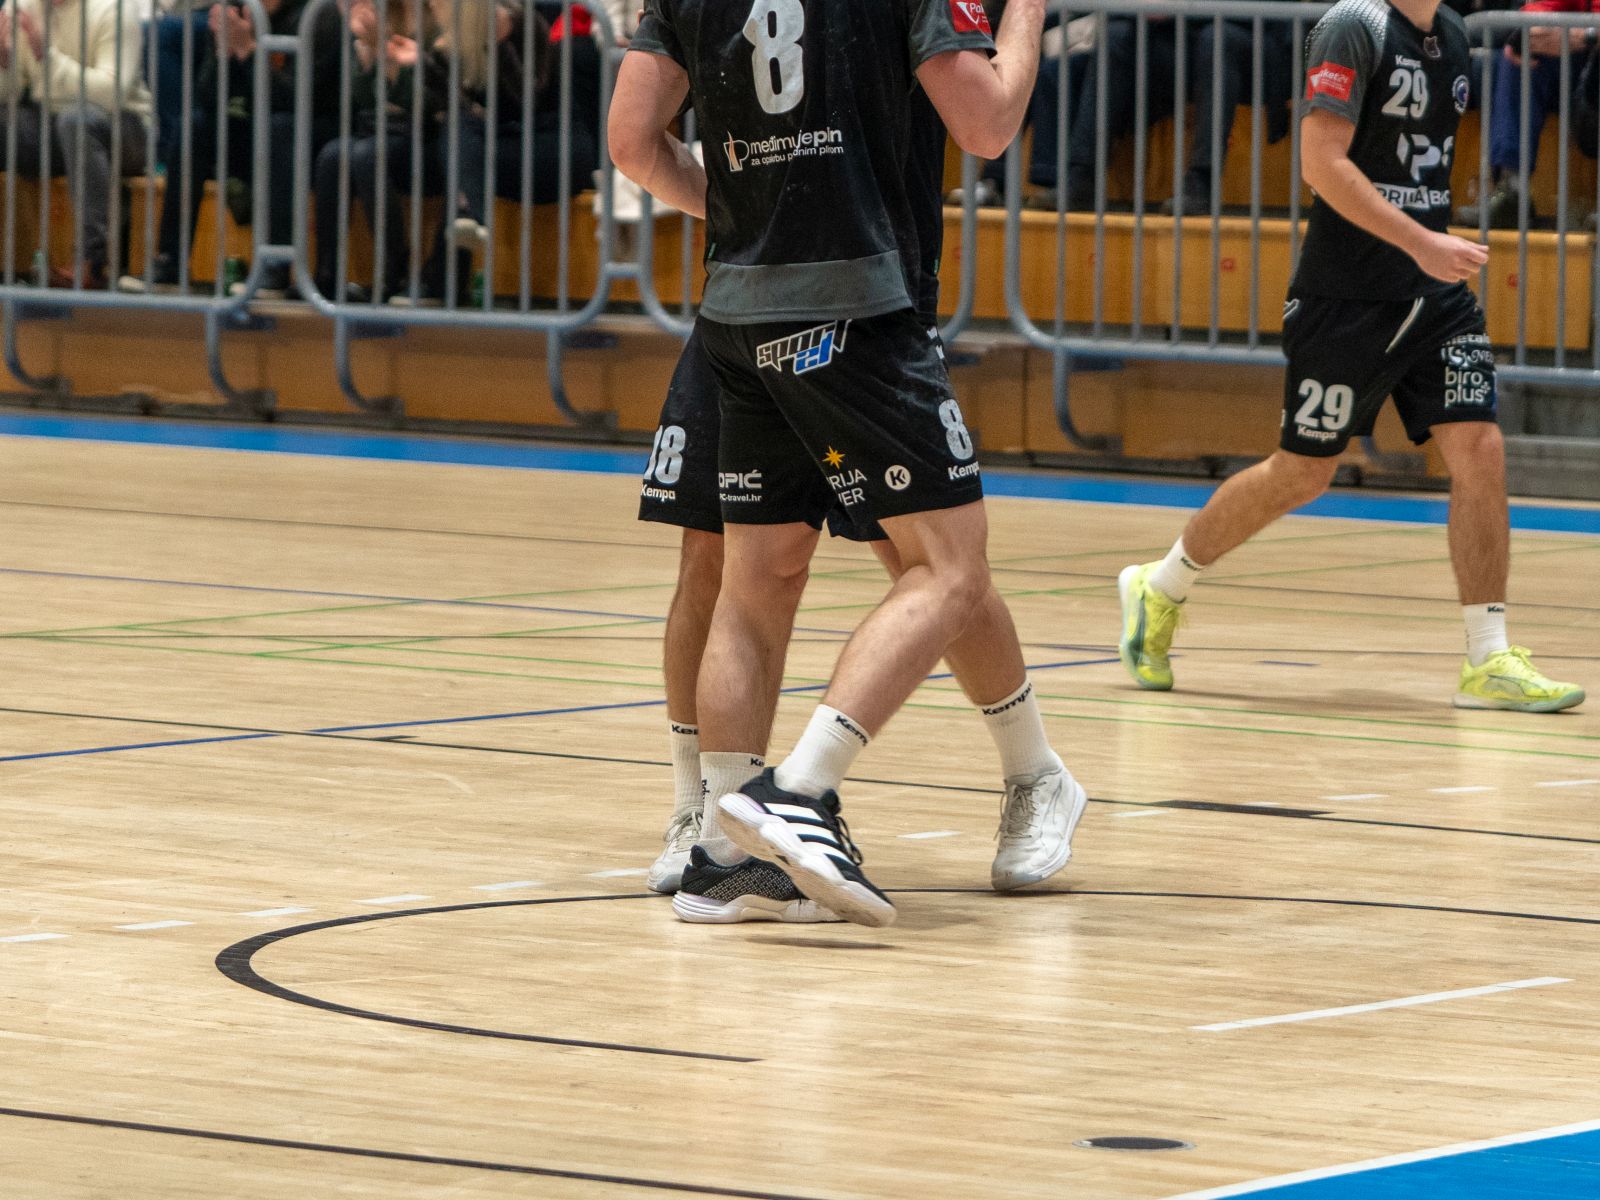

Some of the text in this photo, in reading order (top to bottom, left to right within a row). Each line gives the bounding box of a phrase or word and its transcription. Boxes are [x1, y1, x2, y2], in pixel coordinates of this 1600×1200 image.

[1382, 68, 1428, 118] 29
[1445, 366, 1483, 385] biro
[1294, 378, 1354, 430] 29
[1445, 384, 1485, 408] plus
[938, 399, 973, 460] 8
[1297, 425, 1338, 442] Kempa
[826, 469, 867, 490] RIJA
[947, 461, 980, 481] Kemp
[640, 484, 676, 503] Kempa
